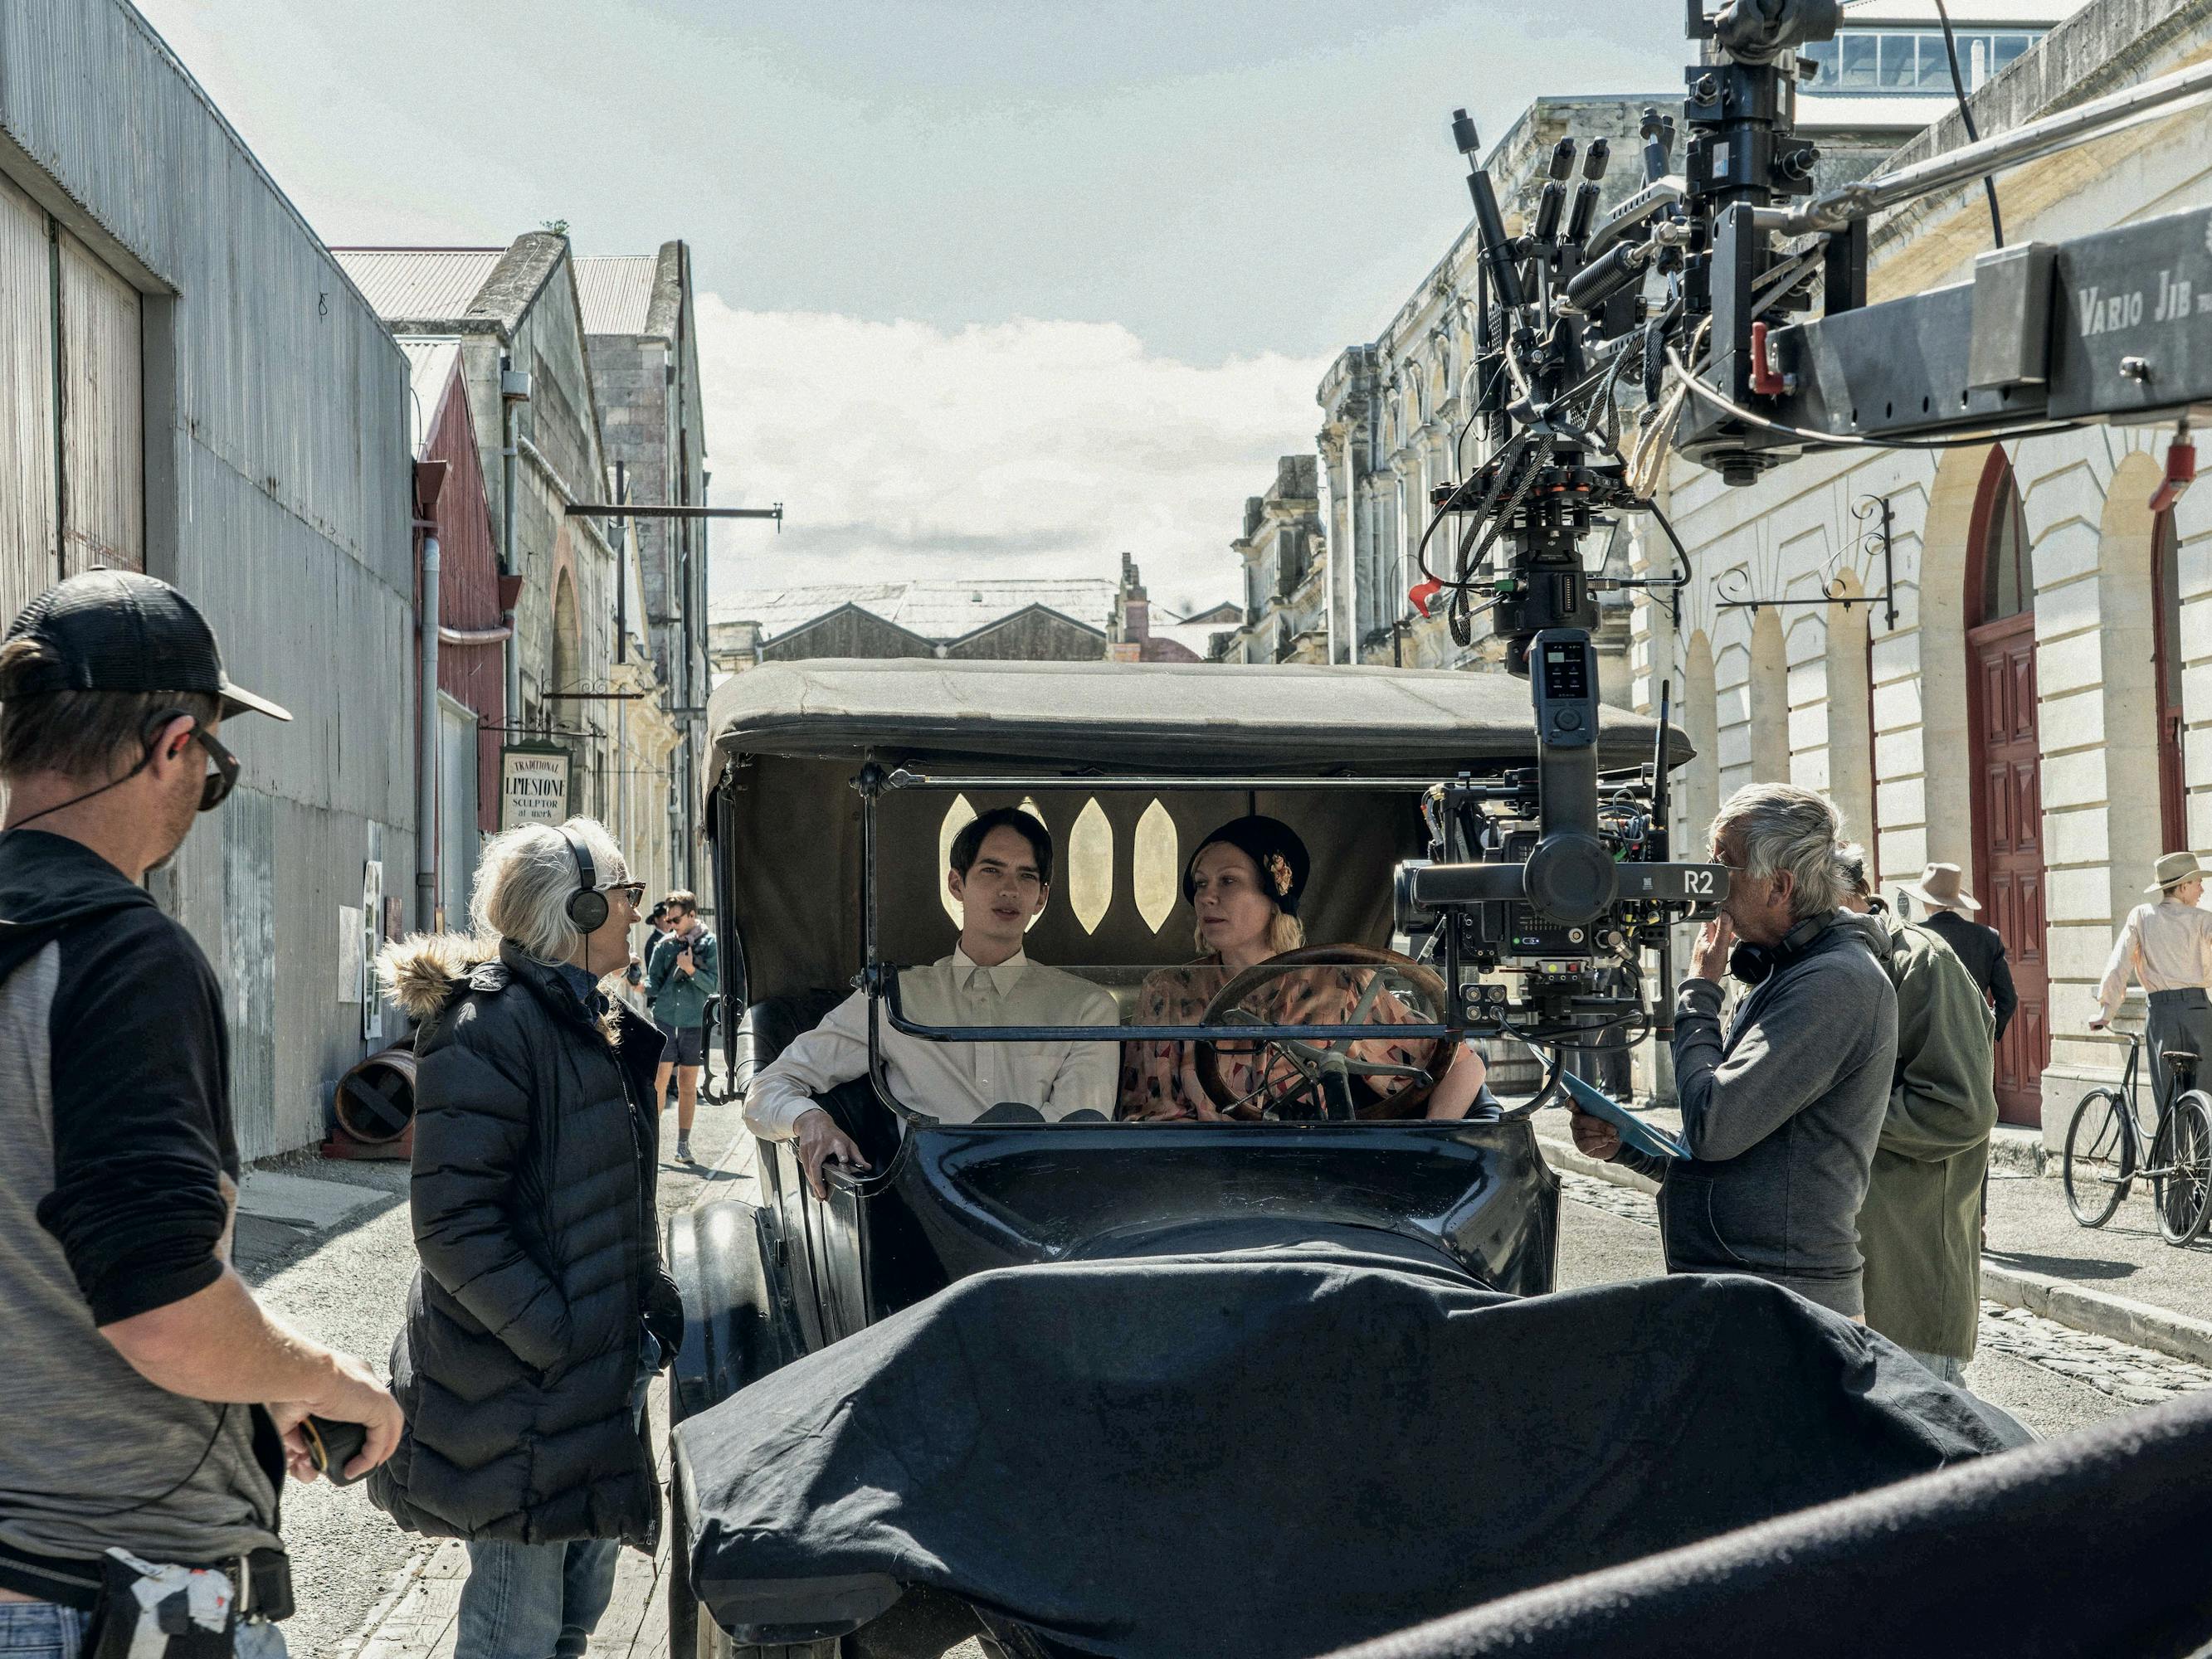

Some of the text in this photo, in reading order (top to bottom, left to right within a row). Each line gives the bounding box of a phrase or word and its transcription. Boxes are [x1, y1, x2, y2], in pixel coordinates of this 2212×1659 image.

[2078, 286, 2144, 338] VARIO
[2154, 270, 2192, 322] JIB
[514, 760, 559, 774] TRADITIONAL
[505, 776, 565, 796] LIMESTONE
[513, 798, 558, 808] SCULPTOR
[518, 809, 552, 818] at work
[1684, 870, 1713, 894] R2
